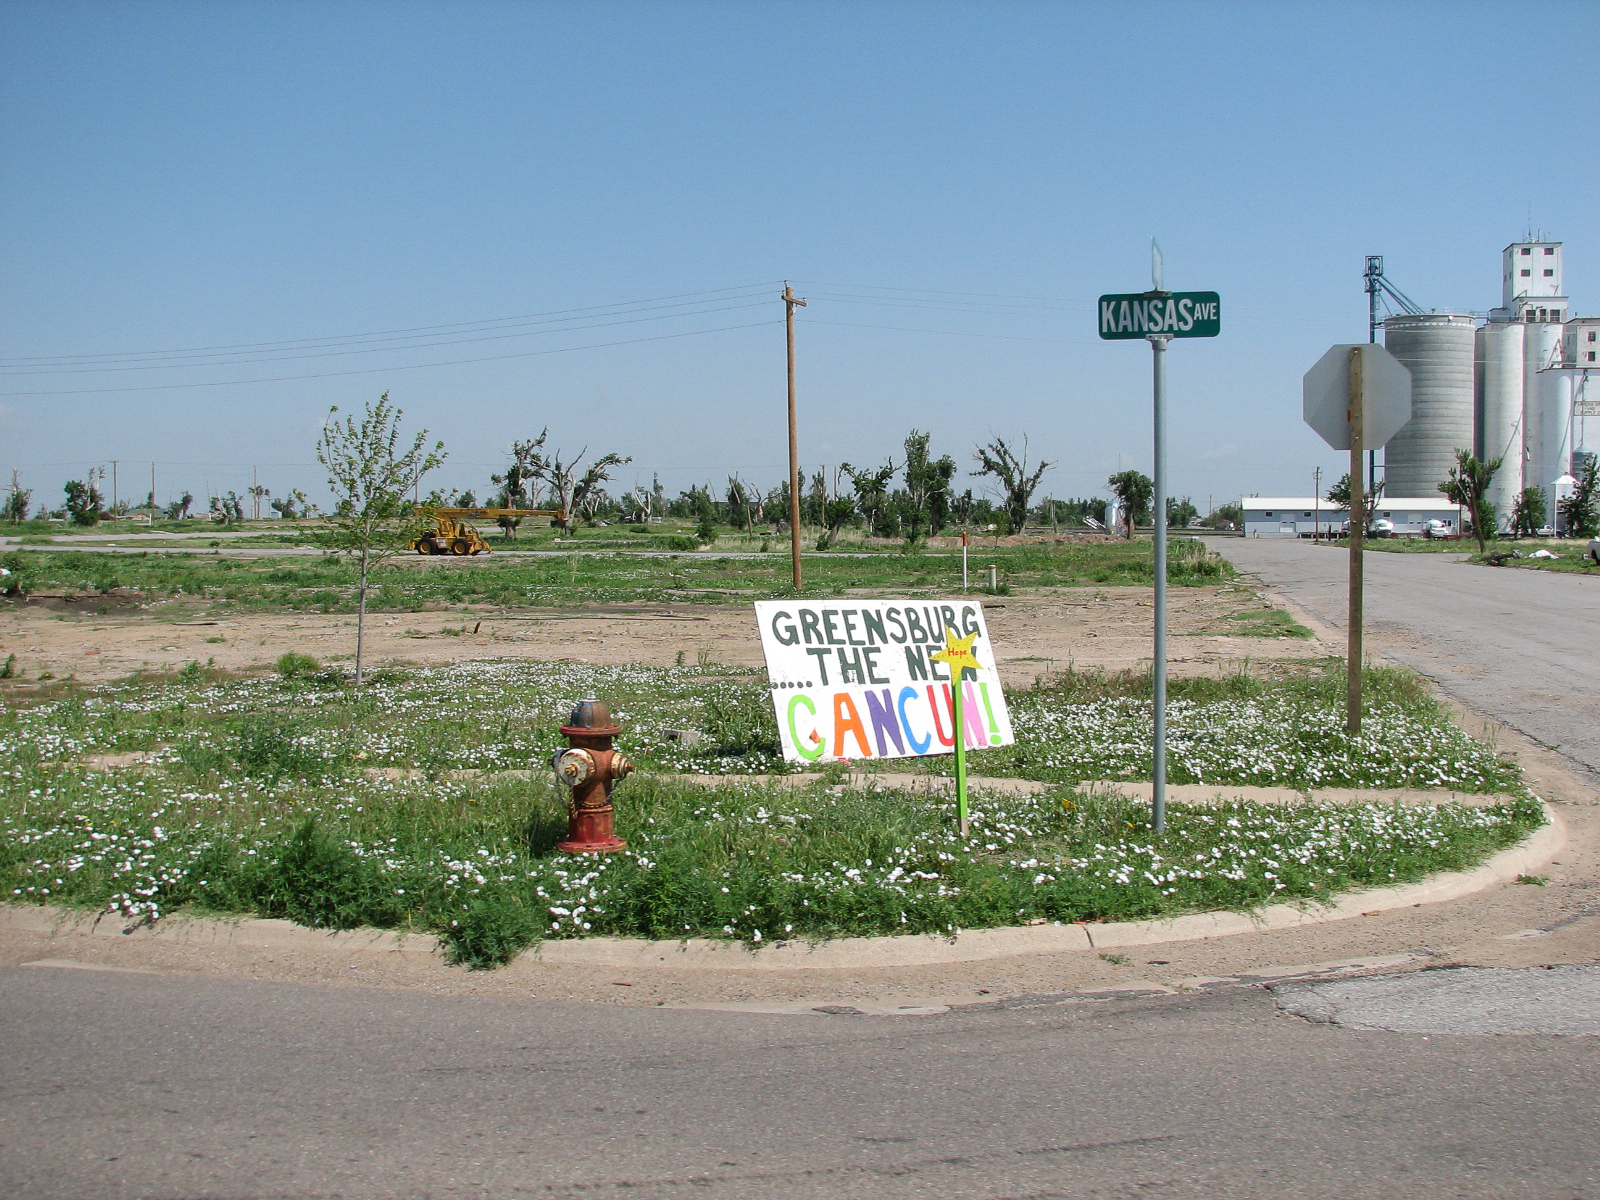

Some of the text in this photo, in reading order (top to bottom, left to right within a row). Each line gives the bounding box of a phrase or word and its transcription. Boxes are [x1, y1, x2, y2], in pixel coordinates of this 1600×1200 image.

[1101, 299, 1218, 333] KANSAS AVE
[772, 605, 982, 647] GREENSBURG
[948, 647, 967, 659] Hope
[787, 681, 1003, 762] CANCUN!
